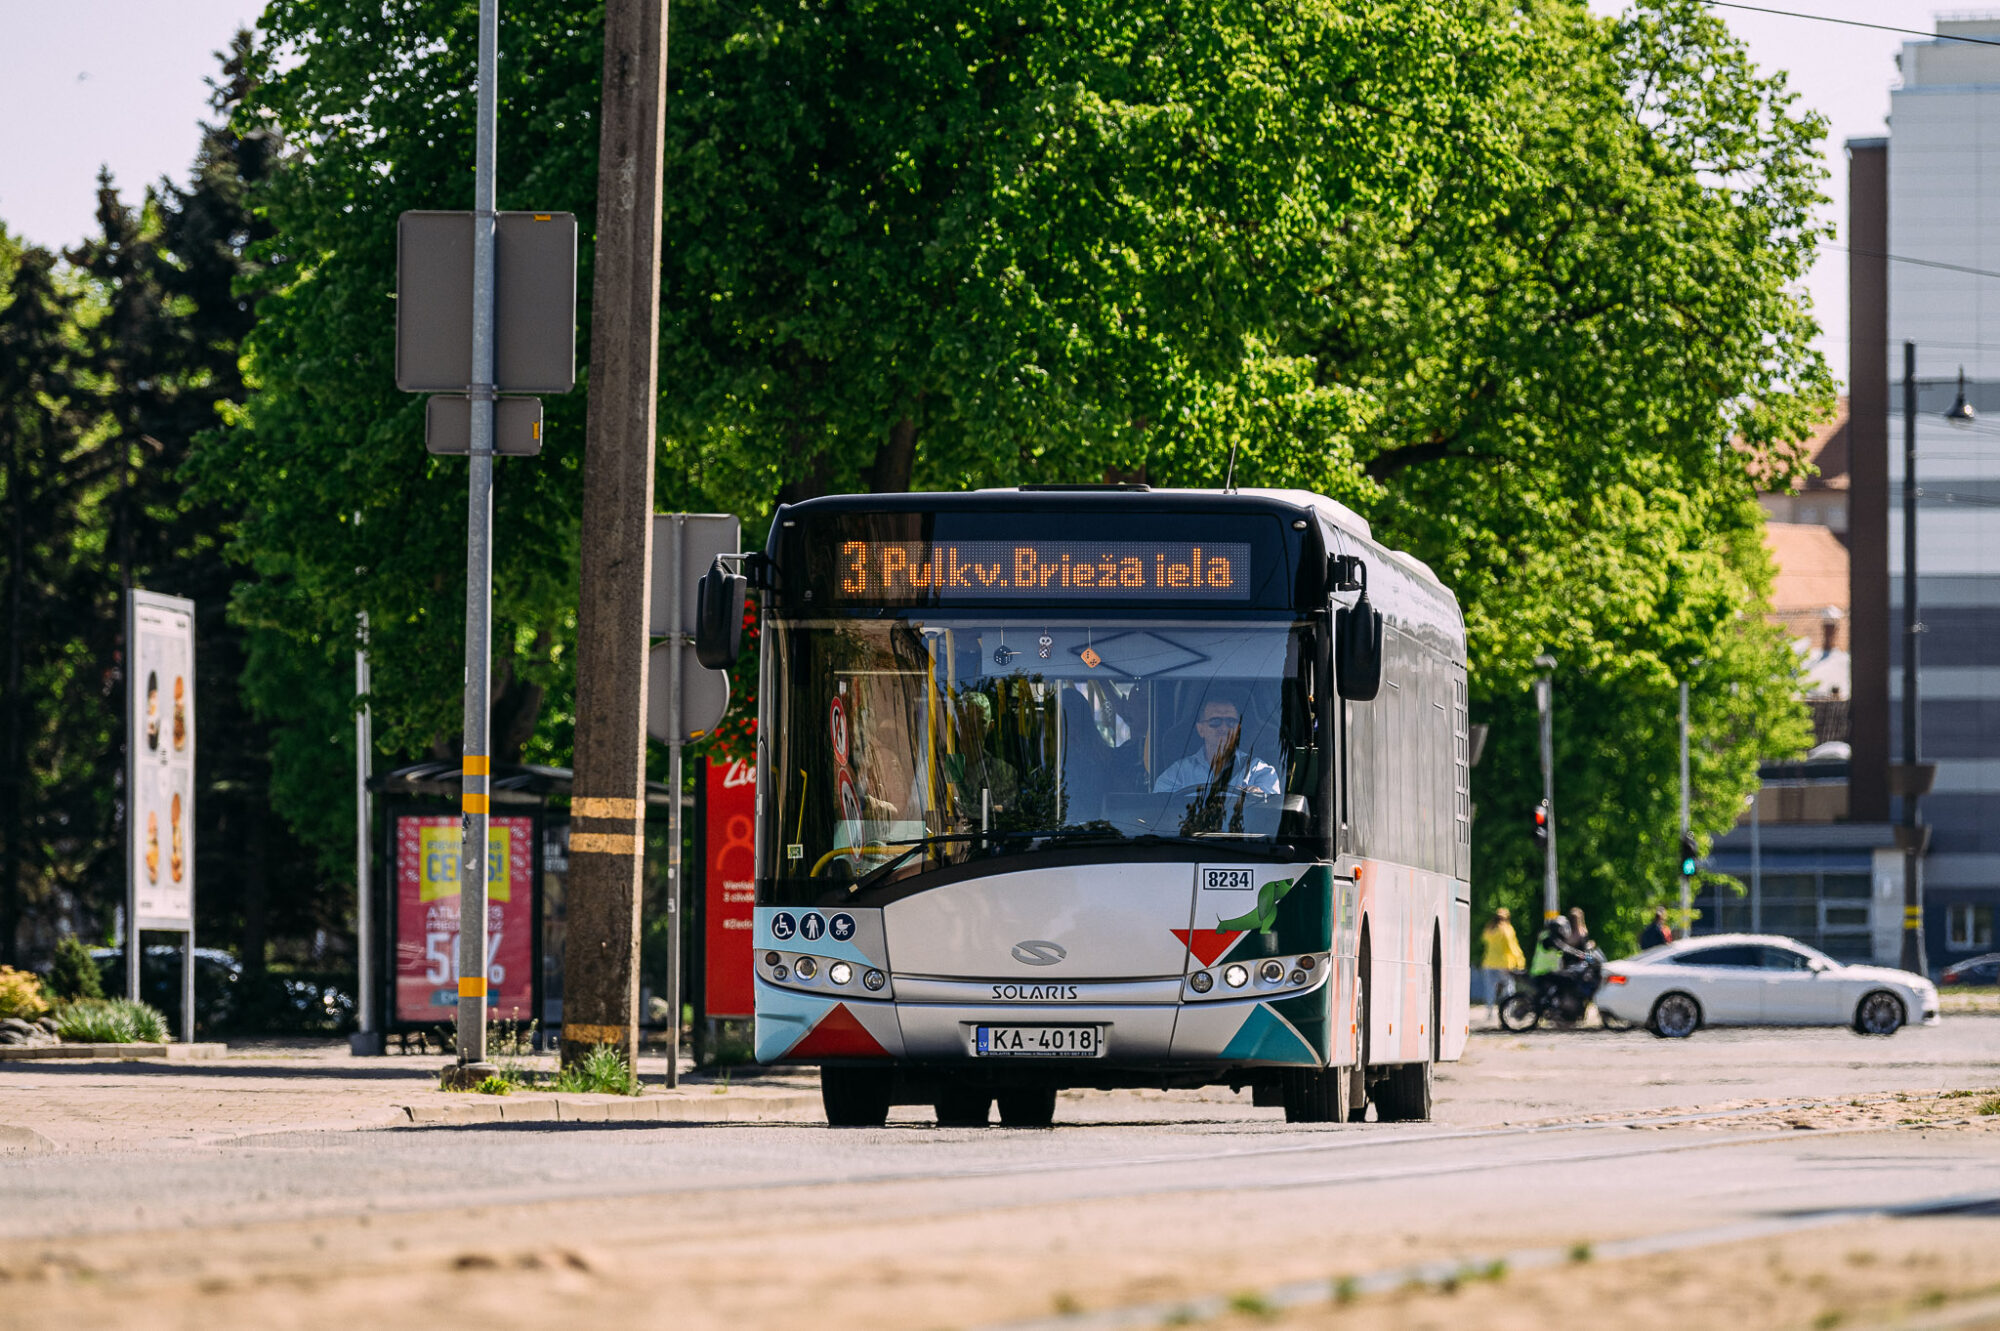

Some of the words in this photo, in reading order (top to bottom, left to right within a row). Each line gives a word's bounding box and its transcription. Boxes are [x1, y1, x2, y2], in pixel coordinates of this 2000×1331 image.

[843, 540, 867, 593] 3
[1156, 547, 1234, 587] iela
[1208, 871, 1250, 888] 8234
[991, 984, 1079, 1000] SOLARIS
[993, 1029, 1092, 1050] KA-4018
